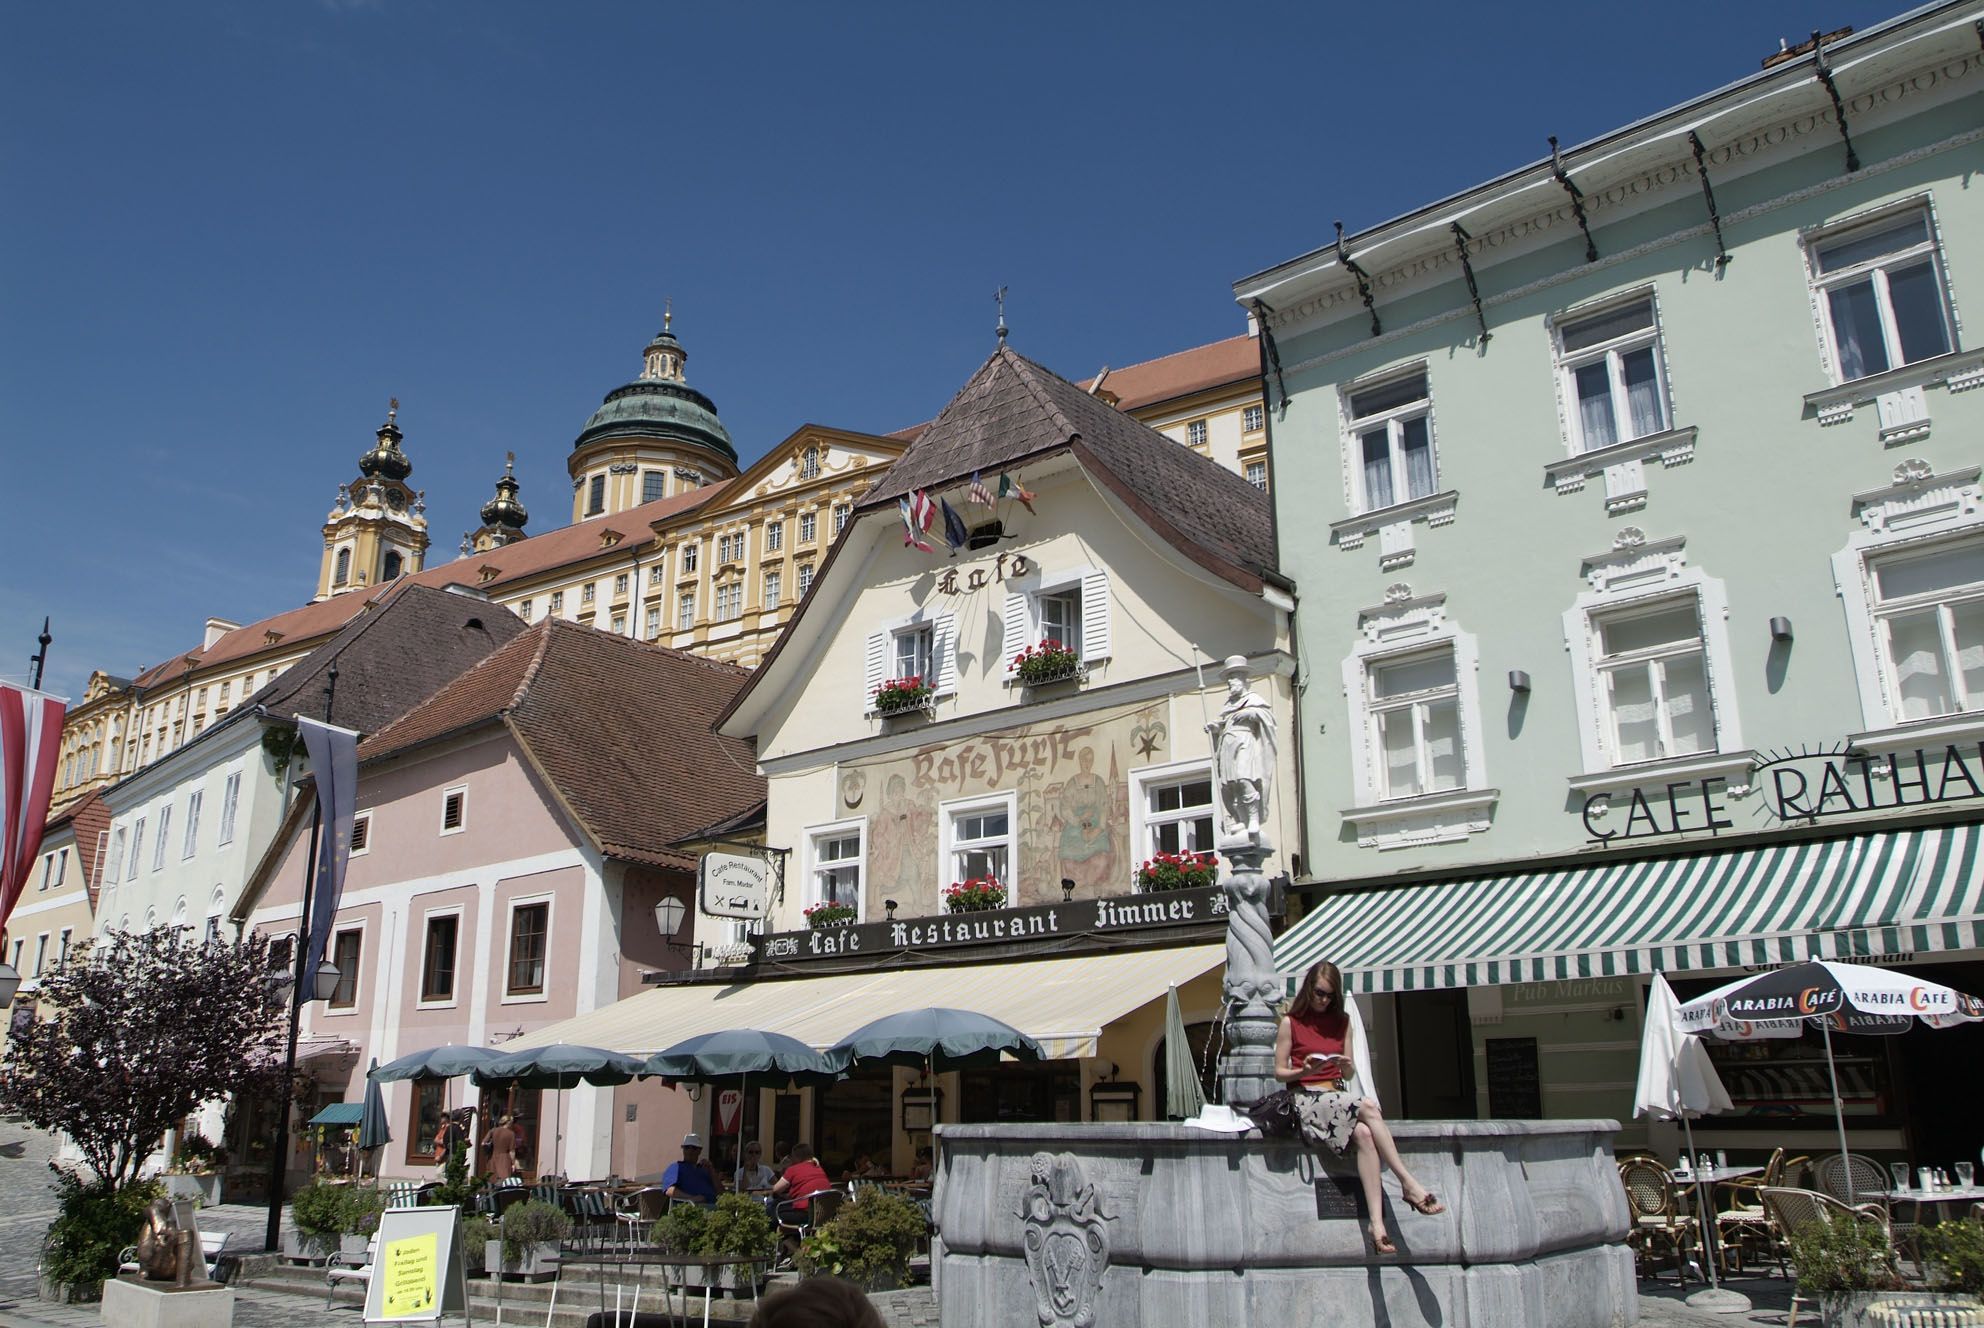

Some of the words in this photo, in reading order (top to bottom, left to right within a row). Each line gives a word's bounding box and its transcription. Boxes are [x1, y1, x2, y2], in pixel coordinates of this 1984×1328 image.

[937, 551, 1030, 597] Cafe
[981, 724, 1094, 788] Fürst
[1582, 776, 1734, 839] CAFE
[1772, 741, 1984, 822] RATHA
[728, 861, 763, 883] Restaurant
[808, 929, 861, 955] Cafe
[890, 909, 1059, 947] Restaurant
[1094, 899, 1195, 928] Zimmer
[1514, 983, 1547, 1001] Pub
[1554, 978, 1625, 998] Markus
[1731, 996, 1795, 1012] ARABIA
[1799, 986, 1837, 1014] CAFÉ
[1854, 991, 1905, 1005] ARABIA
[1910, 986, 1949, 1011] CAFÉ
